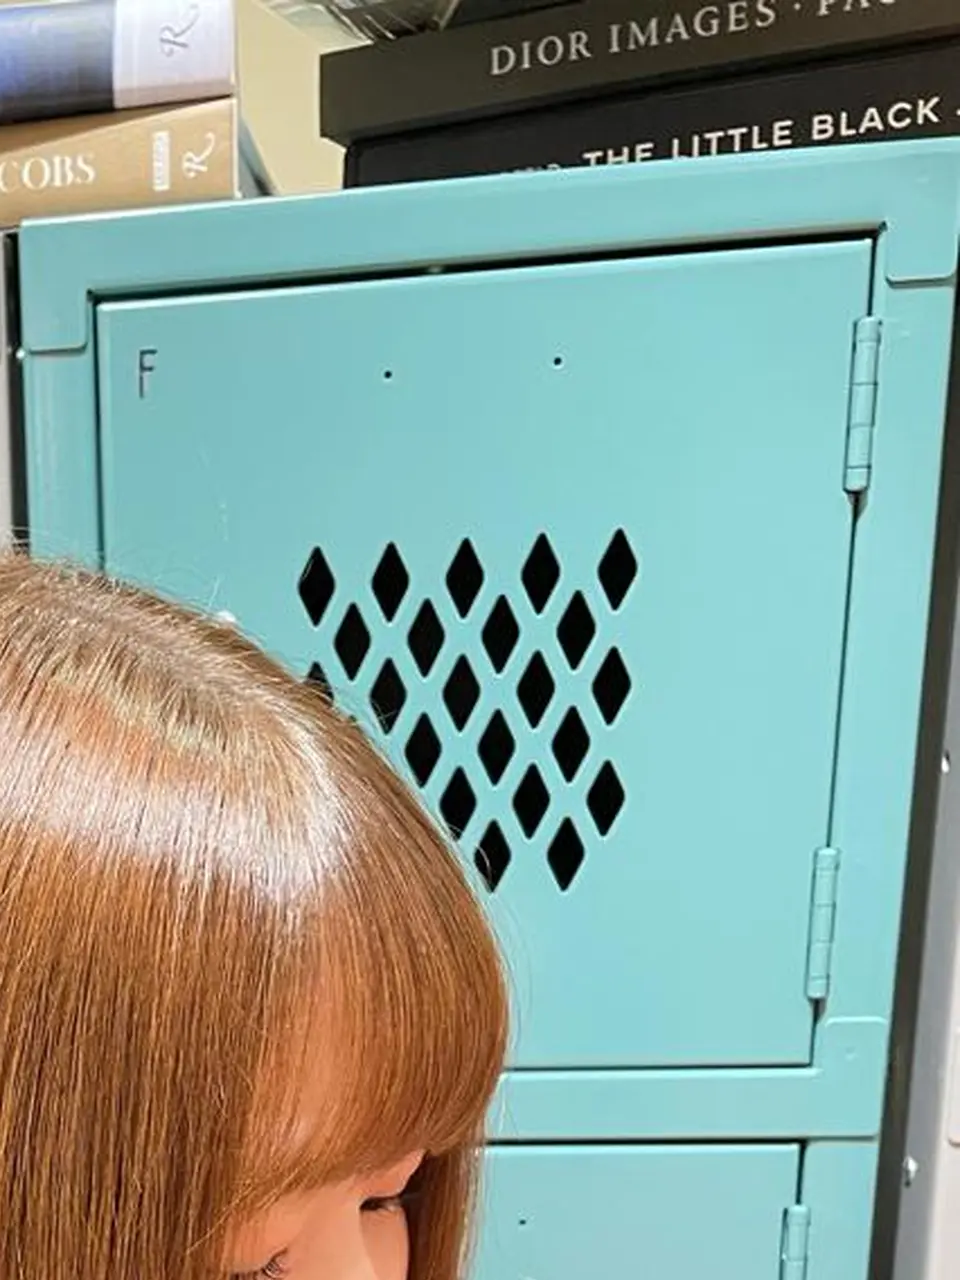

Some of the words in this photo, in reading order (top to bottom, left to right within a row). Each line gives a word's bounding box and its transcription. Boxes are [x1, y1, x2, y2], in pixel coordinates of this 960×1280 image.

[490, 30, 591, 76] DIOR
[608, 0, 776, 53] IMAGES
[582, 142, 654, 167] THE
[671, 119, 793, 160] LITTLE
[811, 97, 940, 141] BLACK
[139, 349, 158, 399] F
